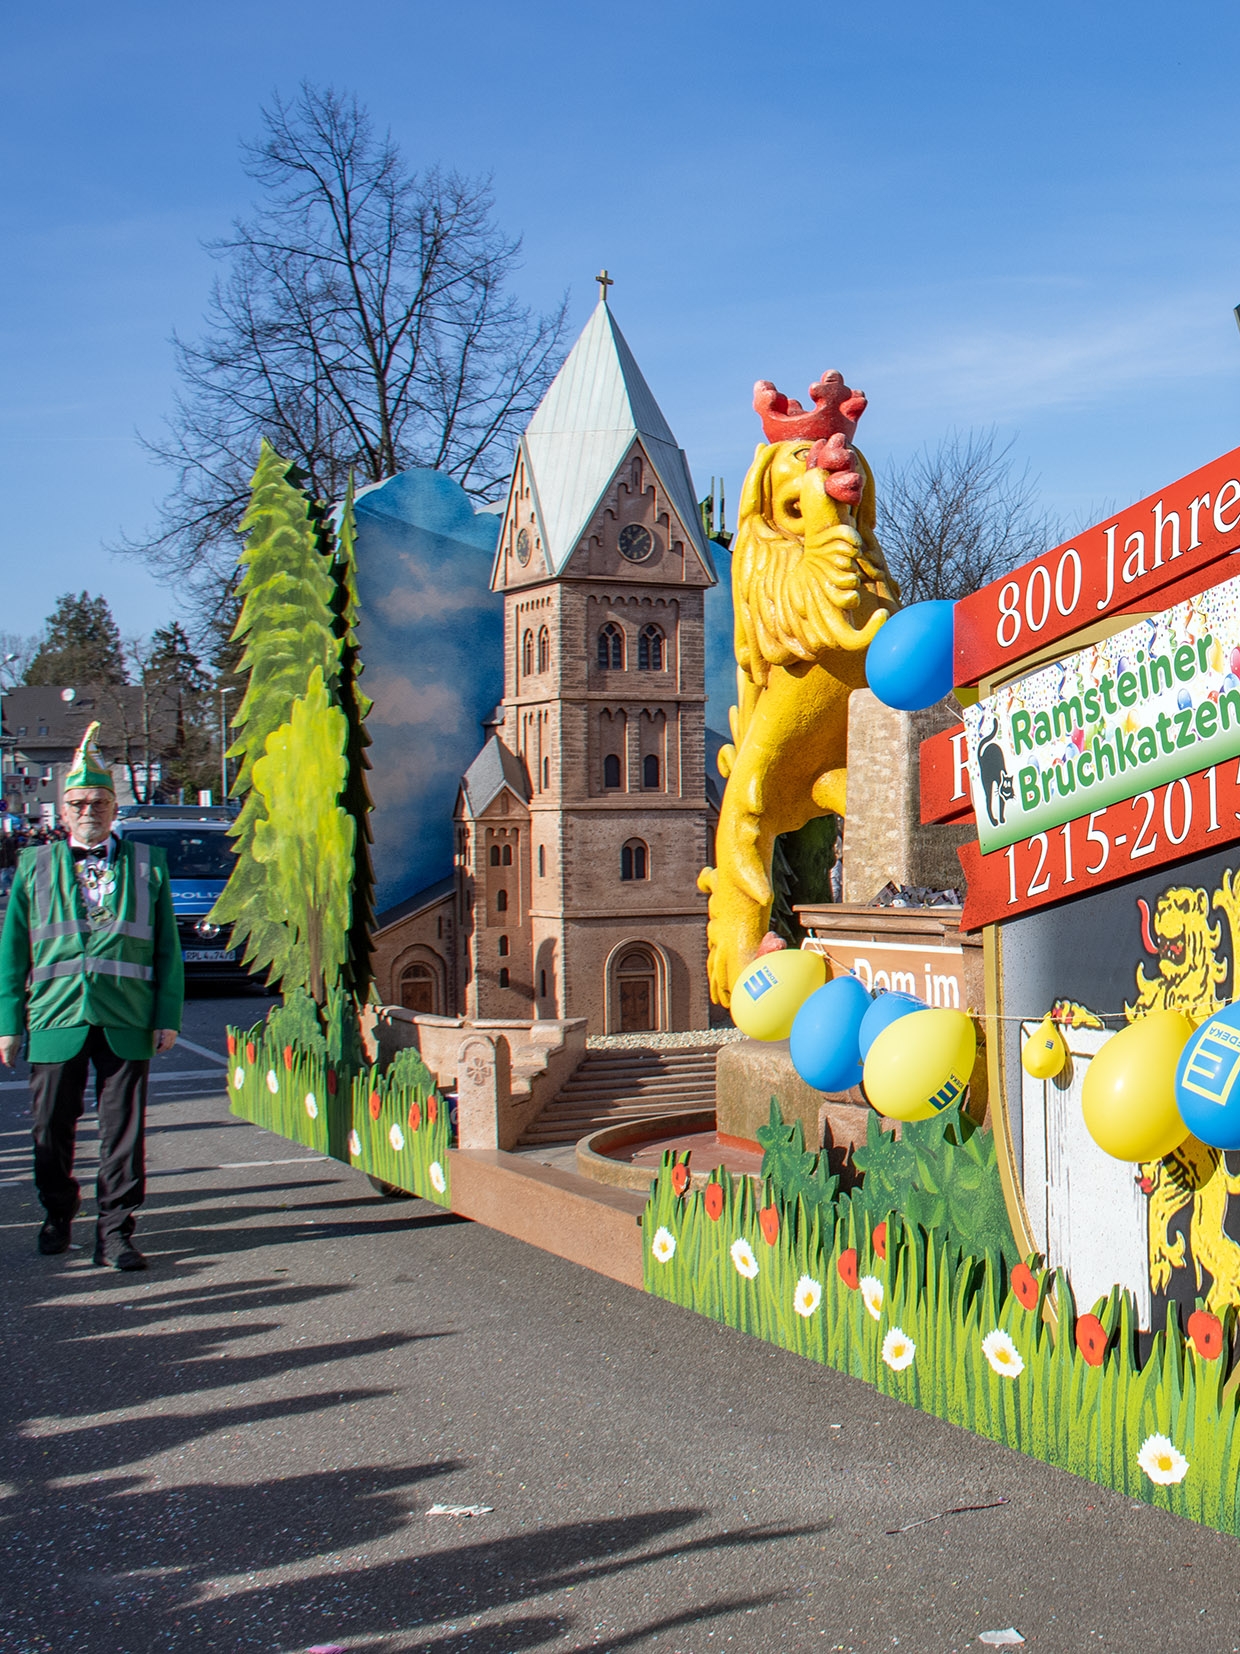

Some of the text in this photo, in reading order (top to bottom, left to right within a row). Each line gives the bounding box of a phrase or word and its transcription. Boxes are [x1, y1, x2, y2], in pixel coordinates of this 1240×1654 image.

[996, 548, 1082, 648] 800
[1011, 633, 1213, 755] Ramsteiner
[854, 957, 960, 1009] Dom im
